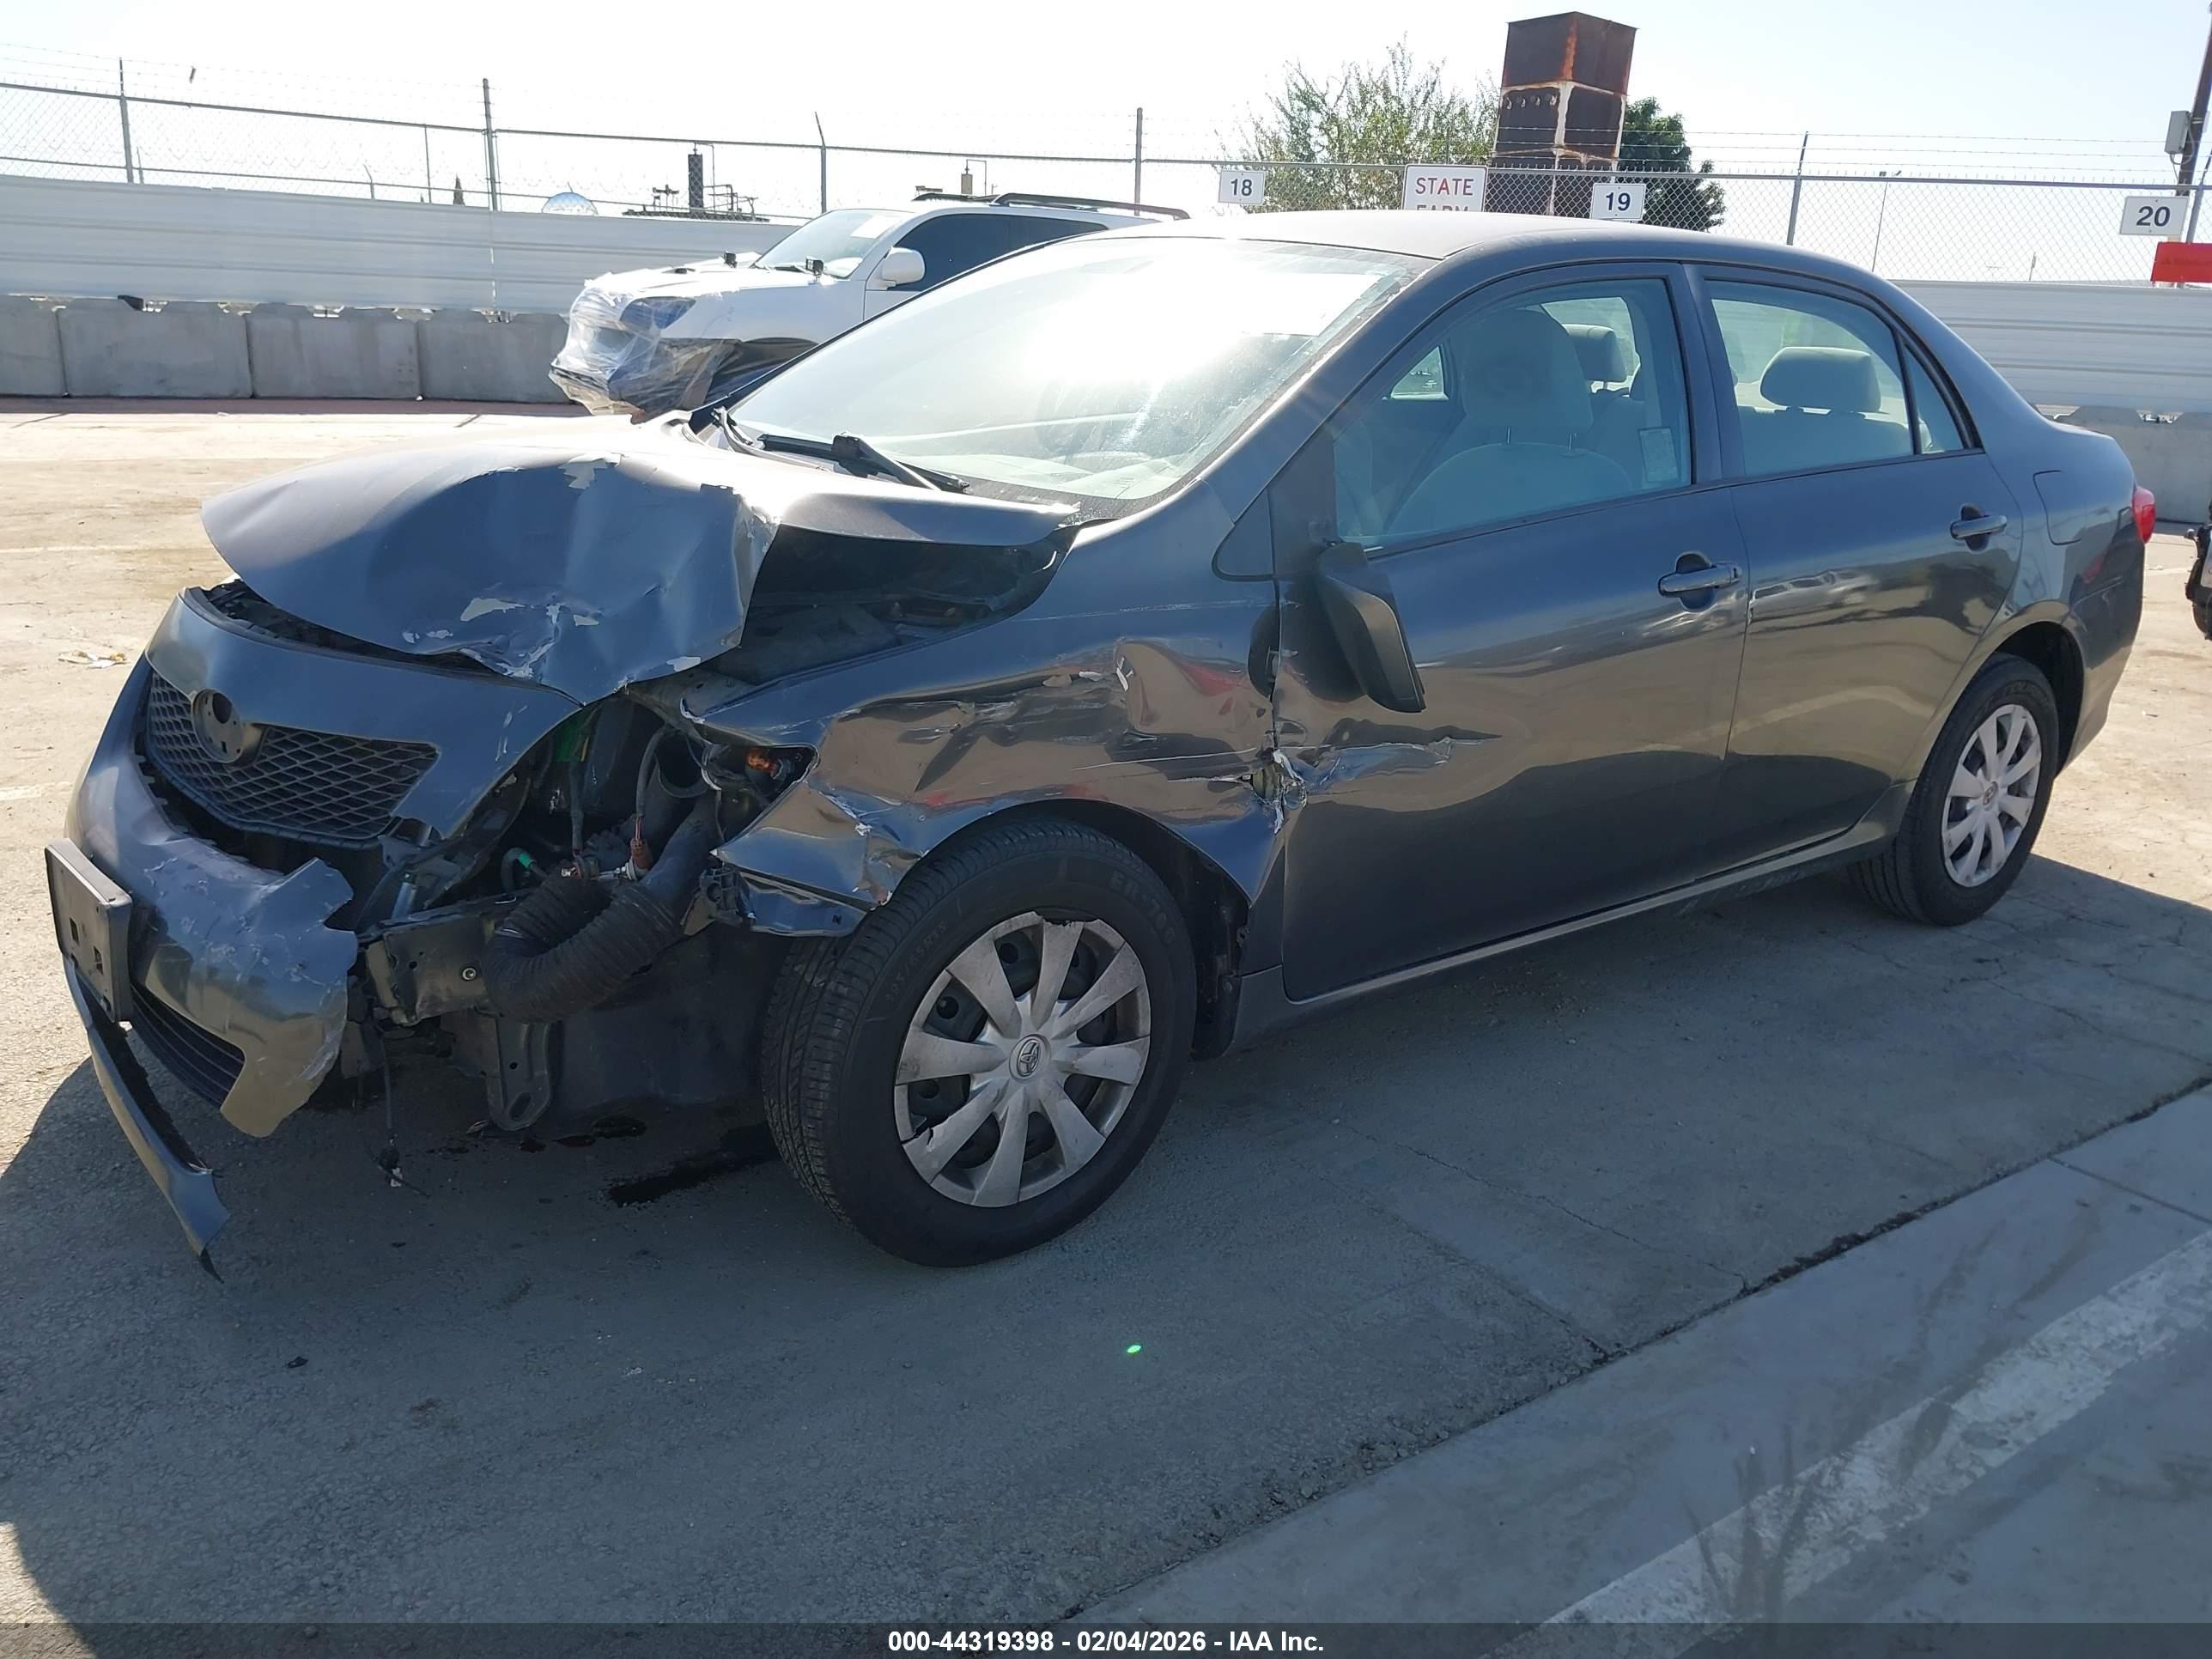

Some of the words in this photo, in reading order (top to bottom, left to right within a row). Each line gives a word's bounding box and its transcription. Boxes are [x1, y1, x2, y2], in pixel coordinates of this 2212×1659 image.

[1231, 179, 1252, 196] 18
[1415, 177, 1474, 196] STATE
[1606, 192, 1631, 211] 19
[2136, 206, 2171, 227] 20
